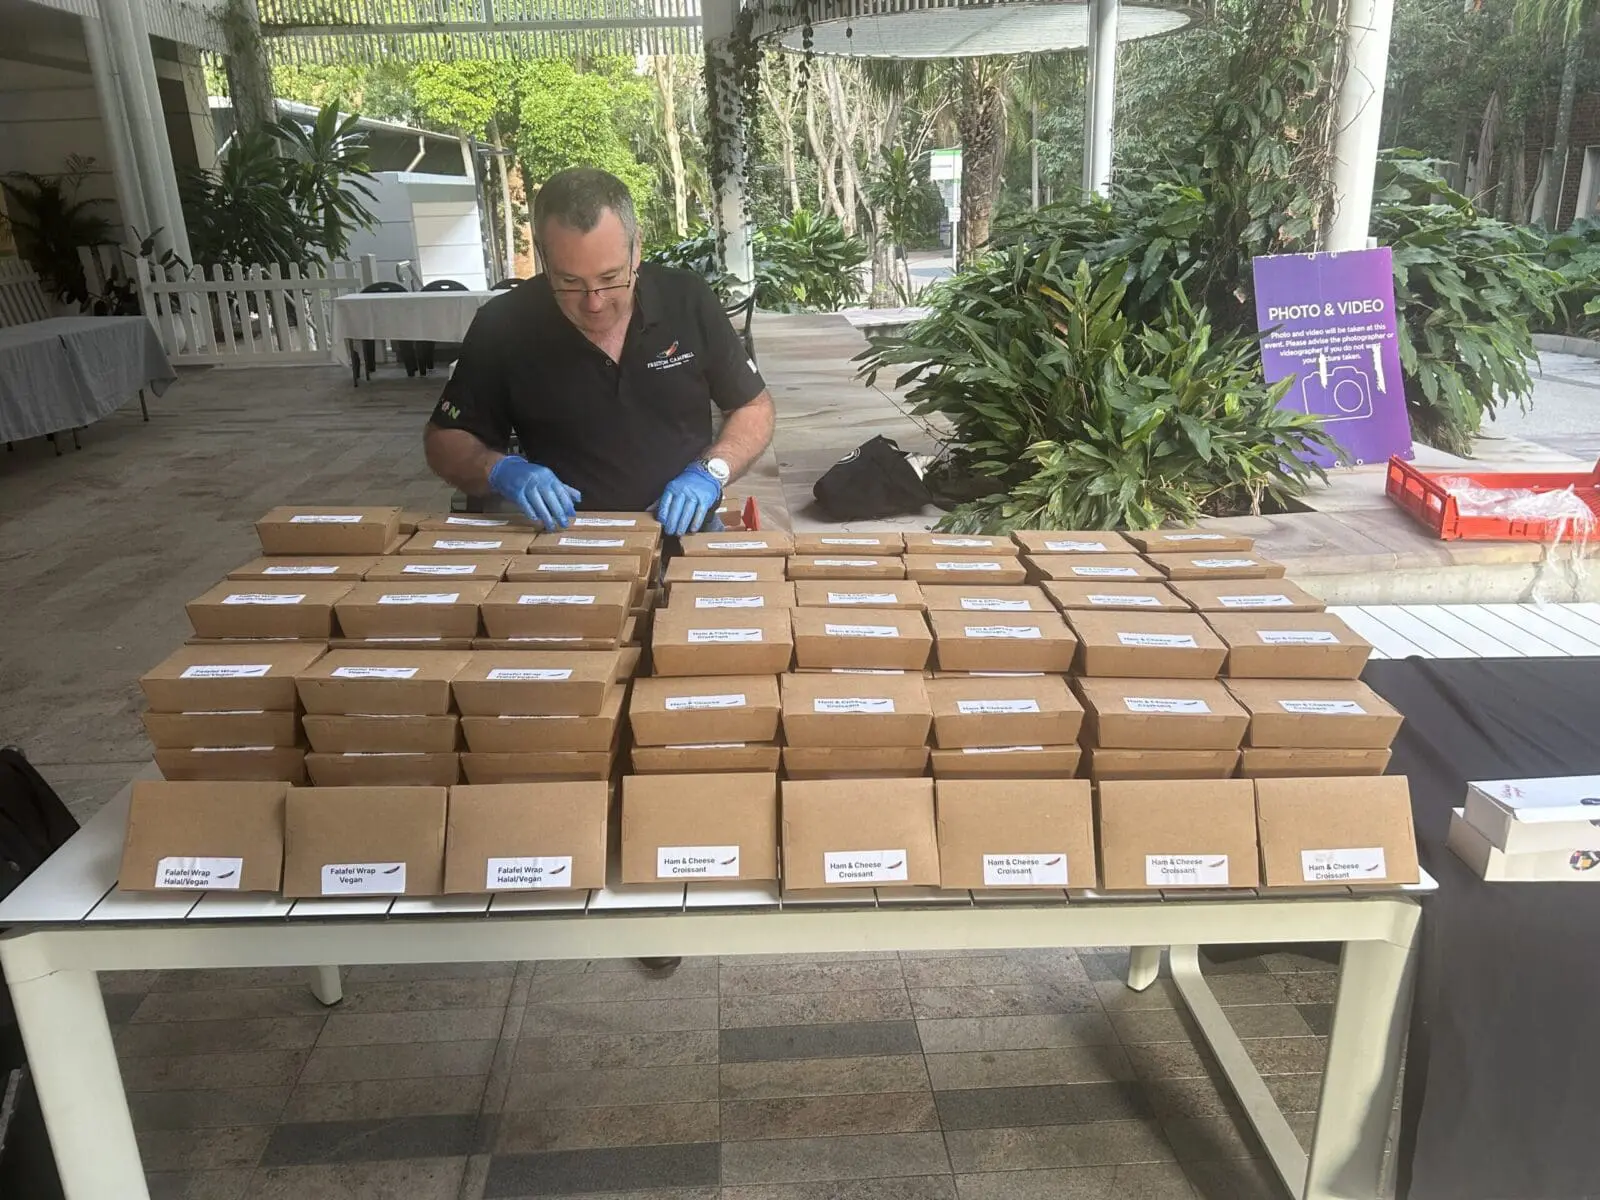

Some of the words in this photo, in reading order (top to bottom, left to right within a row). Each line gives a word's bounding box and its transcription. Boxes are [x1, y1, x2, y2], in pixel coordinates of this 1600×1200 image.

[1268, 303, 1321, 321] PHOTO
[1323, 303, 1335, 317] &
[1337, 299, 1385, 315] VIDEO
[1270, 331, 1291, 340] Photo
[1292, 330, 1305, 338] and
[1305, 329, 1324, 337] video
[1325, 327, 1337, 335] will
[1347, 325, 1366, 333] taken
[1374, 322, 1386, 331] this
[1264, 341, 1285, 349] event.
[1285, 338, 1307, 347] Please
[1307, 337, 1329, 346] advise
[1330, 335, 1341, 344] the
[1342, 332, 1386, 344] photographer
[1386, 331, 1395, 339] or
[1279, 347, 1323, 358] videographer
[1330, 346, 1343, 354] you
[1343, 343, 1353, 352] do
[1353, 342, 1365, 351] not
[1302, 356, 1317, 366] your
[1342, 352, 1362, 362] taken.
[664, 857, 681, 865] Ham
[681, 857, 688, 865] &
[688, 856, 716, 865] Cheese
[987, 858, 1005, 867] Ham
[1005, 858, 1012, 866] &
[1012, 858, 1040, 866] Cheese
[1152, 858, 1169, 867] Ham
[1169, 858, 1176, 866] &
[1176, 858, 1204, 866] Cheese
[672, 865, 707, 874] Croissant
[830, 862, 847, 870] Ham
[854, 861, 882, 870] Cheese
[1308, 864, 1325, 872] Ham
[1326, 863, 1332, 871] &
[1333, 863, 1360, 871] Cheese
[165, 869, 190, 877] Falafel
[190, 869, 211, 878] Wrap
[330, 867, 355, 876] Falafel
[355, 867, 377, 876] Wrap
[497, 866, 523, 875] Falafel
[524, 866, 544, 876] Wrap
[838, 870, 874, 879] Croissant
[997, 867, 1032, 875] Croissant
[1161, 866, 1197, 875] Croissant
[497, 875, 543, 884] Halal/Vegan
[1315, 871, 1351, 880] Croissant
[164, 877, 209, 887] Halal/Vegan
[339, 876, 364, 885] Vegan
